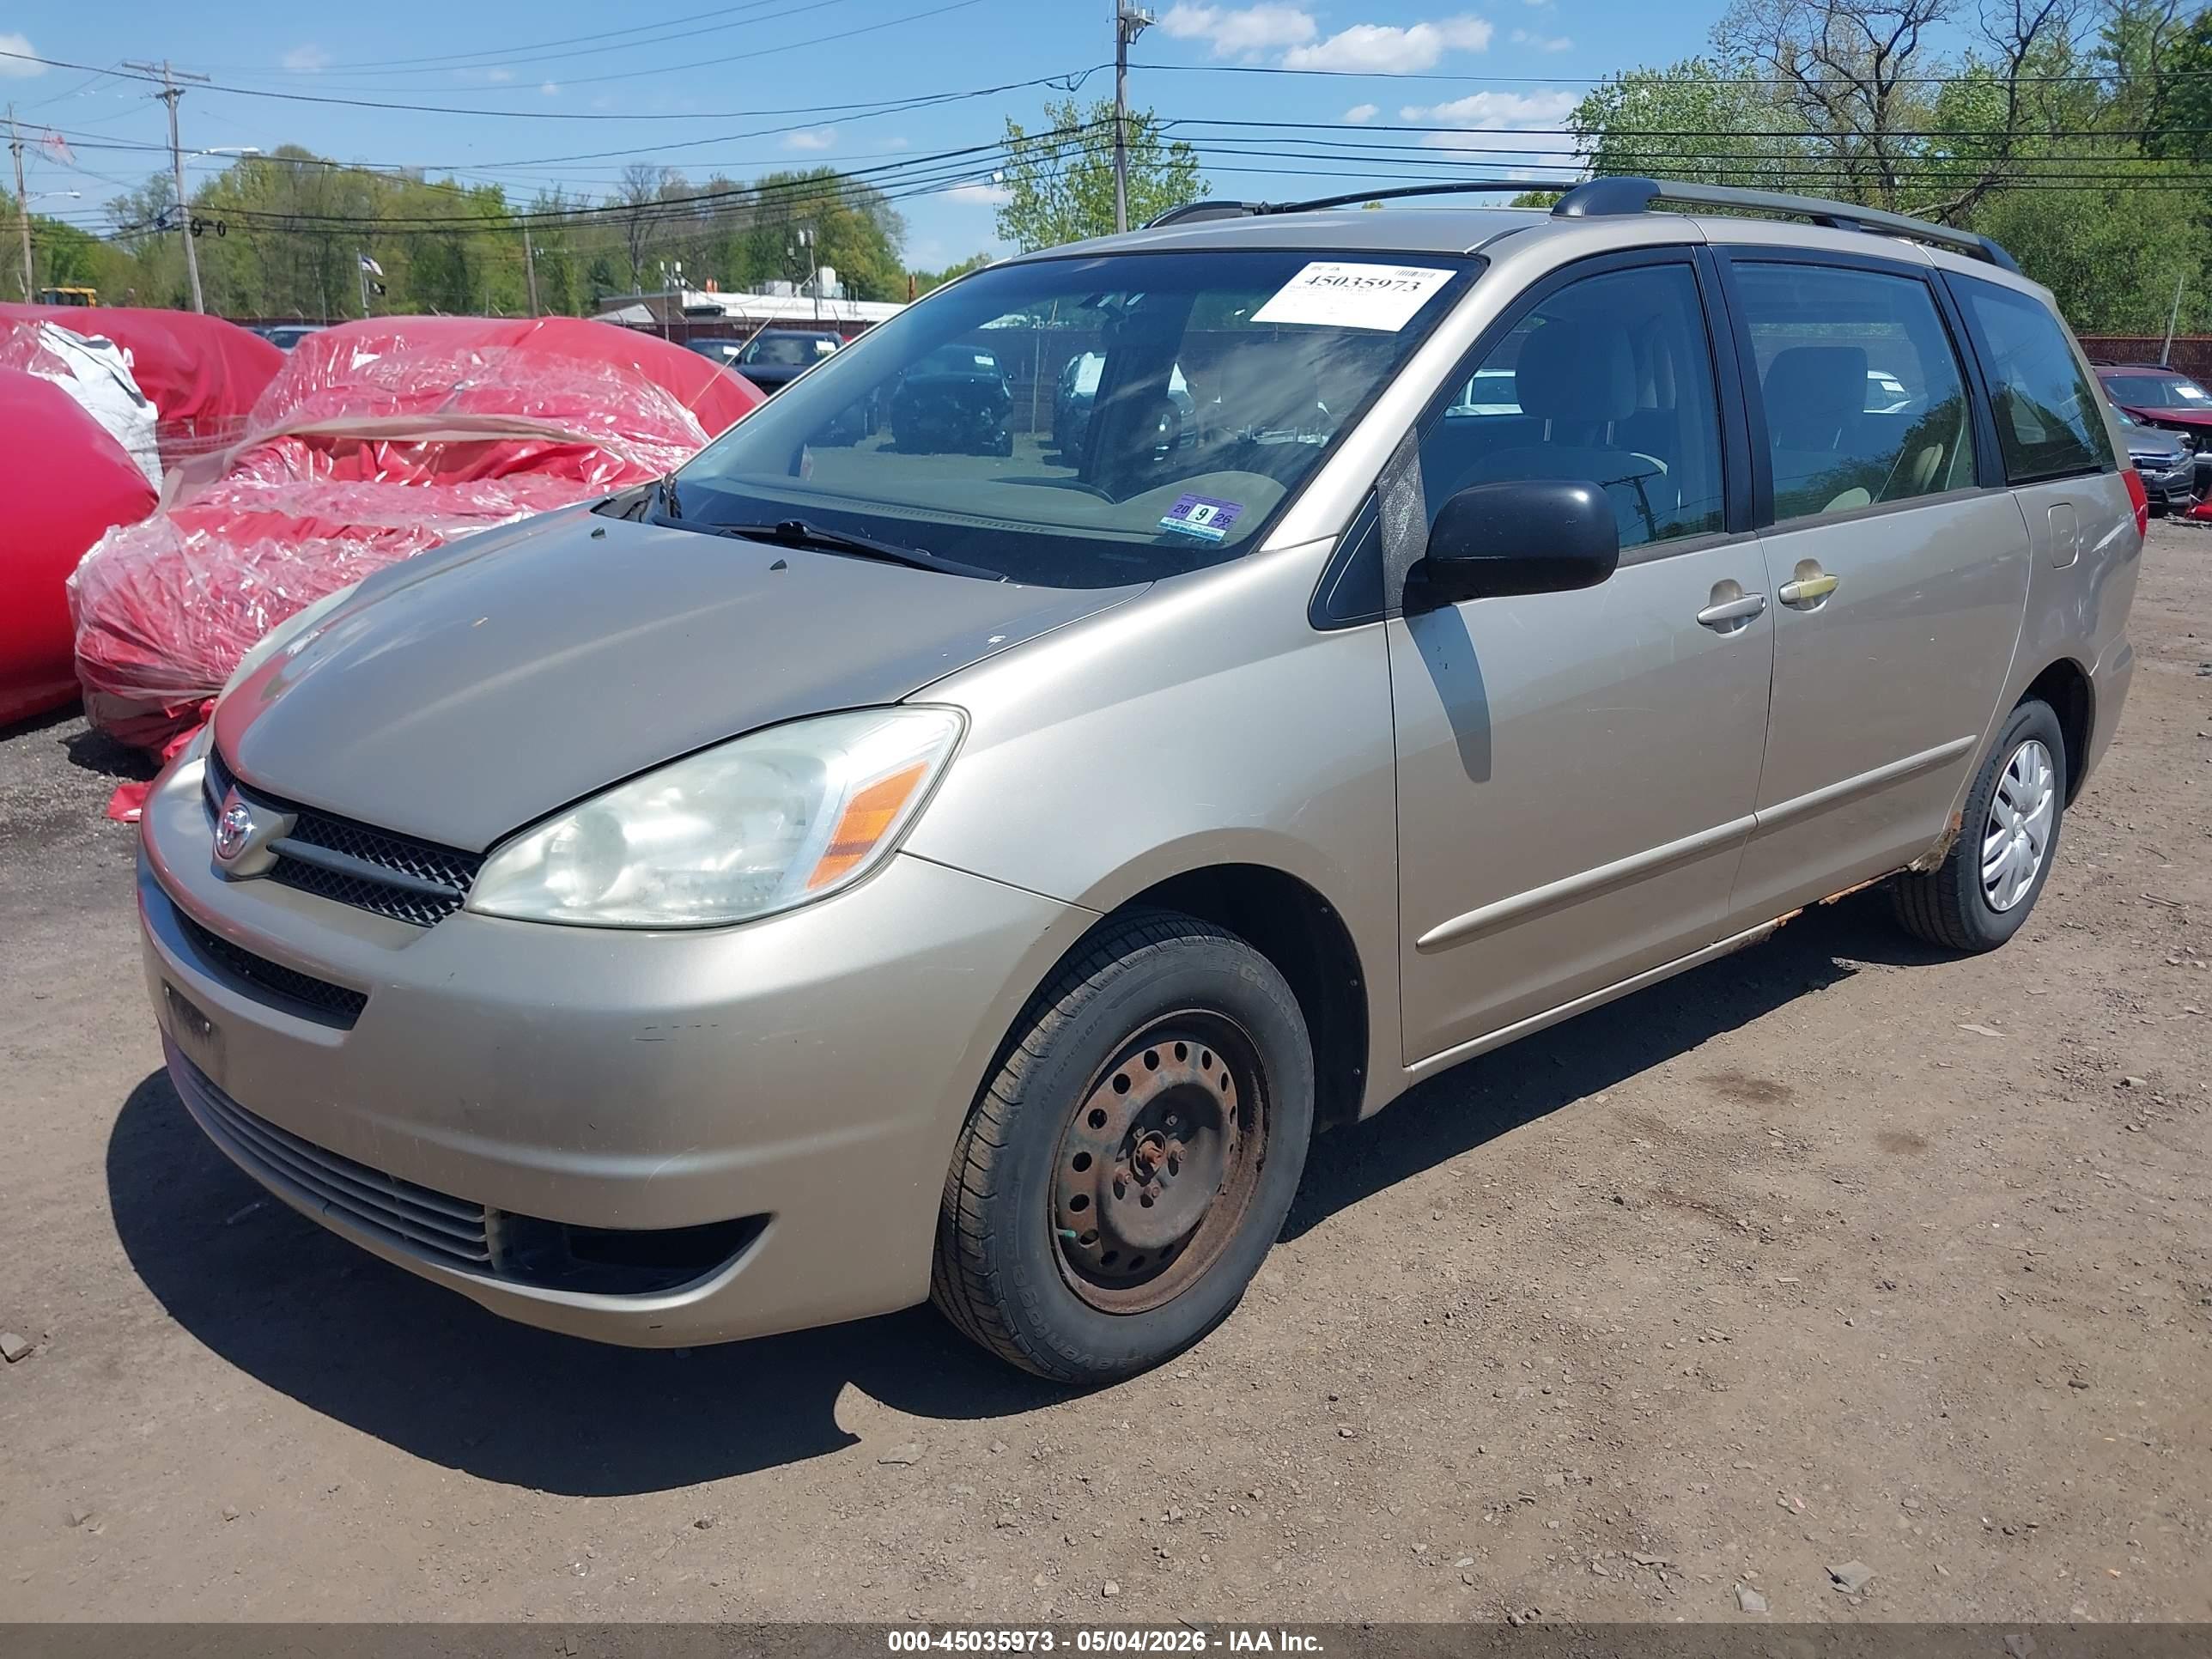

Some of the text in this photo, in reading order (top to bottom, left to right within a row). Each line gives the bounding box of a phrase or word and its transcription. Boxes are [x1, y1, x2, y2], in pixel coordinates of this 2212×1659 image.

[1304, 275, 1422, 293] 45035973
[1173, 504, 1233, 524] 20 9 26
